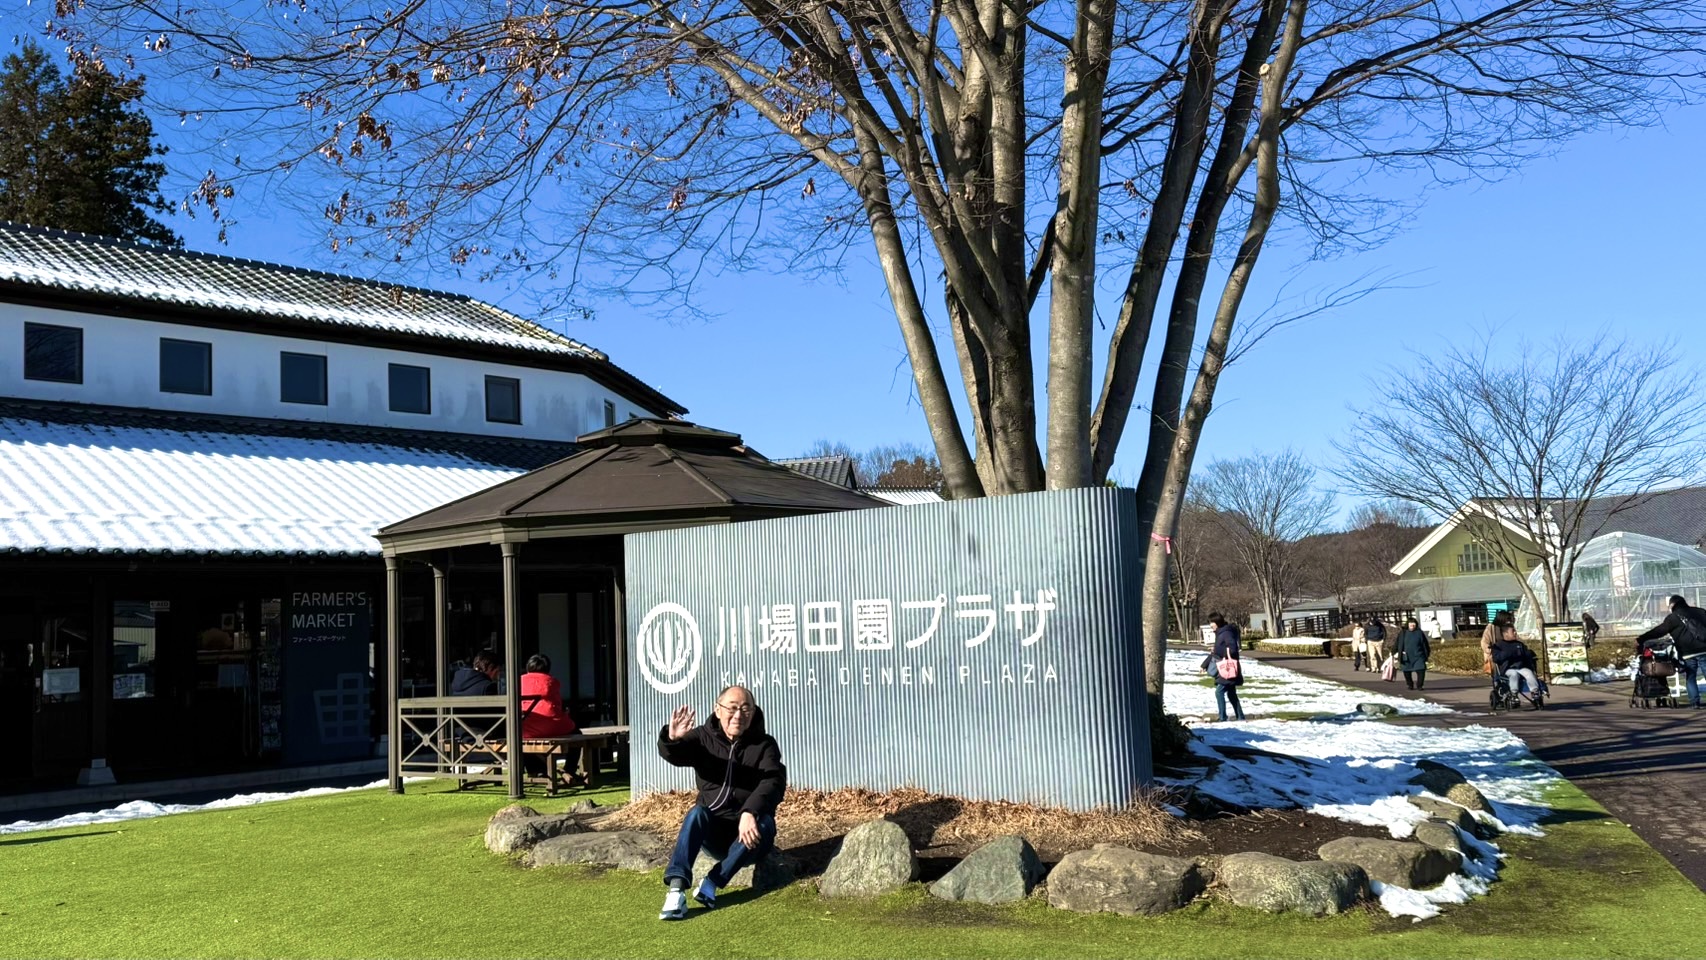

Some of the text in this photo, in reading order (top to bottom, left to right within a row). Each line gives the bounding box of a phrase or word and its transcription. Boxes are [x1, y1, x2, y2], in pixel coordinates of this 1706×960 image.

[292, 591, 366, 606] FARMER'S
[292, 613, 356, 629] MARKET
[716, 587, 1058, 657] 川場田園プラザ
[721, 663, 1059, 688] KAWABA DENEN PLAZA
